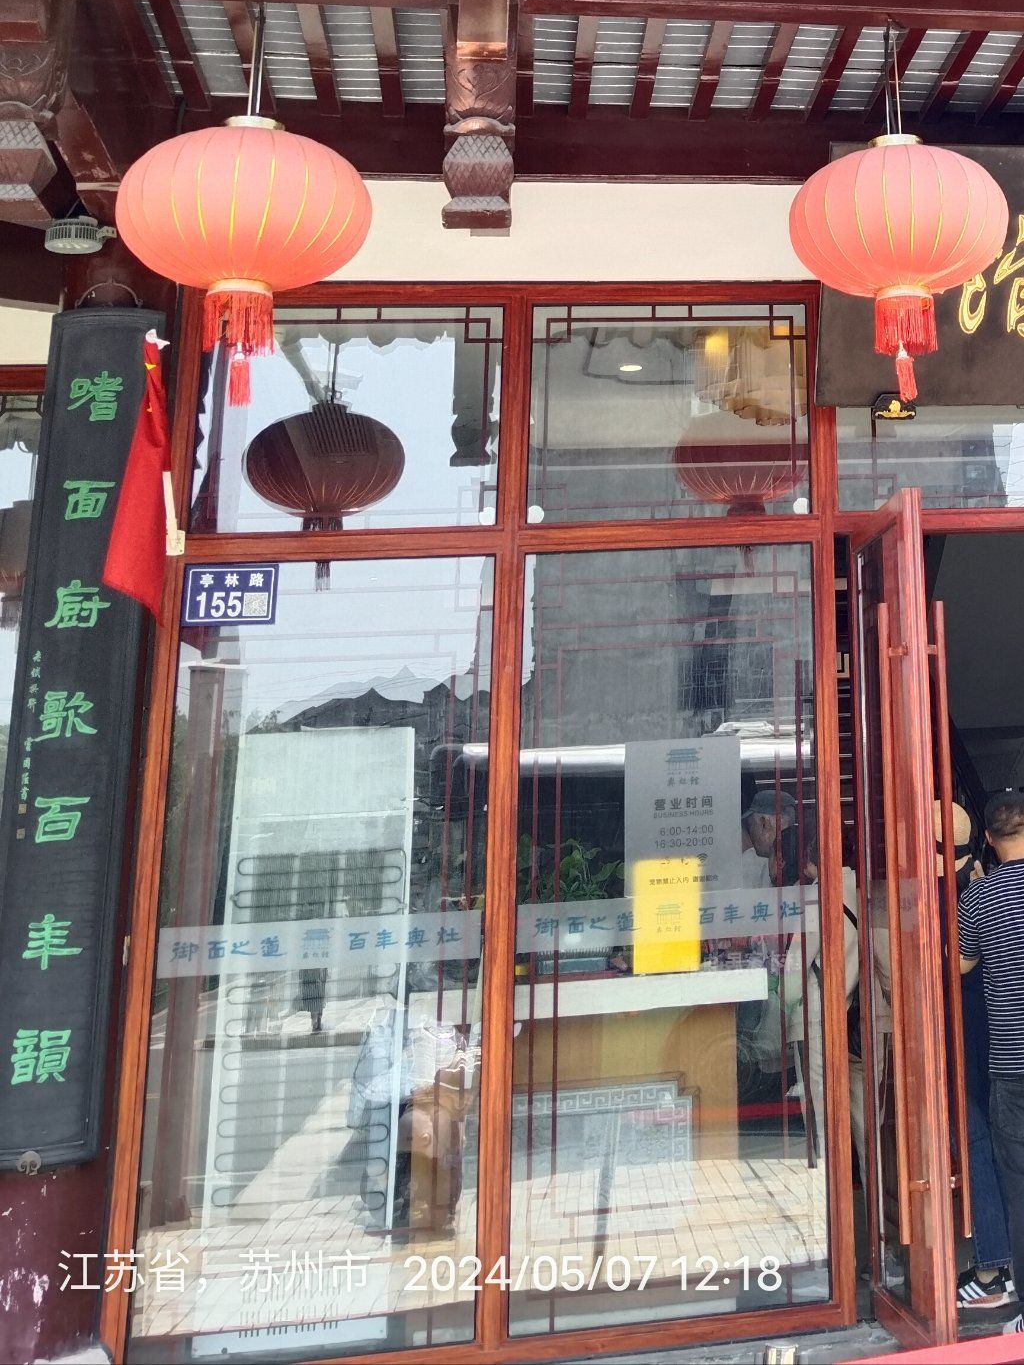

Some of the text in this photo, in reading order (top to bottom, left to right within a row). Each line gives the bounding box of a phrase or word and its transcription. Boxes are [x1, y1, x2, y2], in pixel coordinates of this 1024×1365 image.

[199, 572, 265, 589] 亭林路
[195, 591, 243, 618] 155
[654, 795, 714, 811] 营业时间
[653, 809, 714, 820] BUSINESS HOURS
